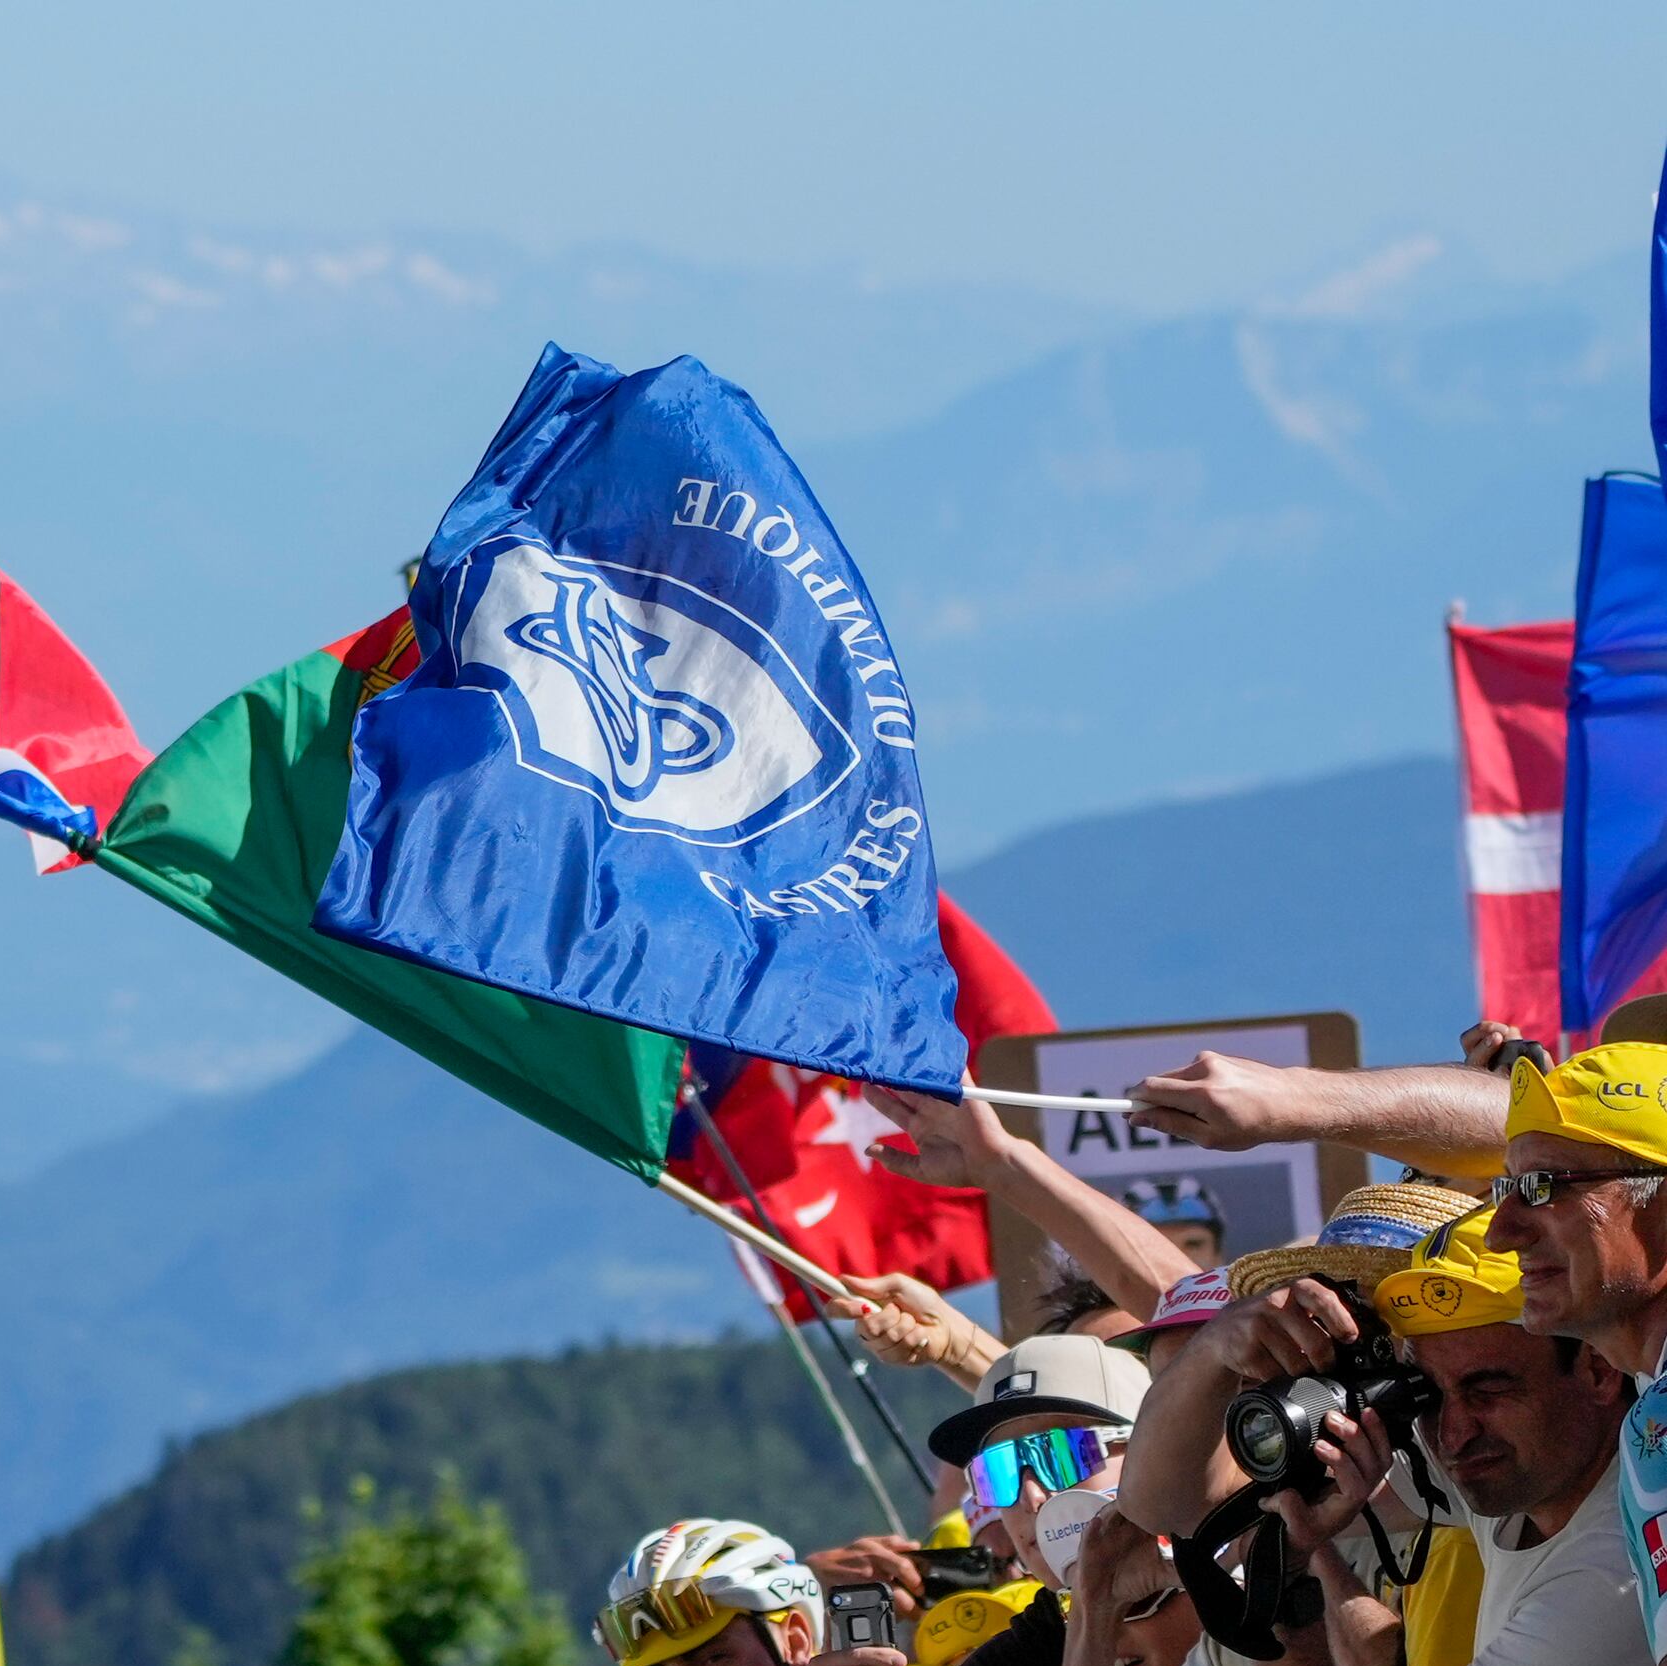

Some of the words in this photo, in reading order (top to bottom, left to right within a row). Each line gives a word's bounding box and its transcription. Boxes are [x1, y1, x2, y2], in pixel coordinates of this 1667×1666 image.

[671, 476, 917, 751] OLYMPIQUE
[699, 798, 922, 921] CASTRES
[1602, 1082, 1649, 1098] LCL
[1391, 1296, 1419, 1307] LCL
